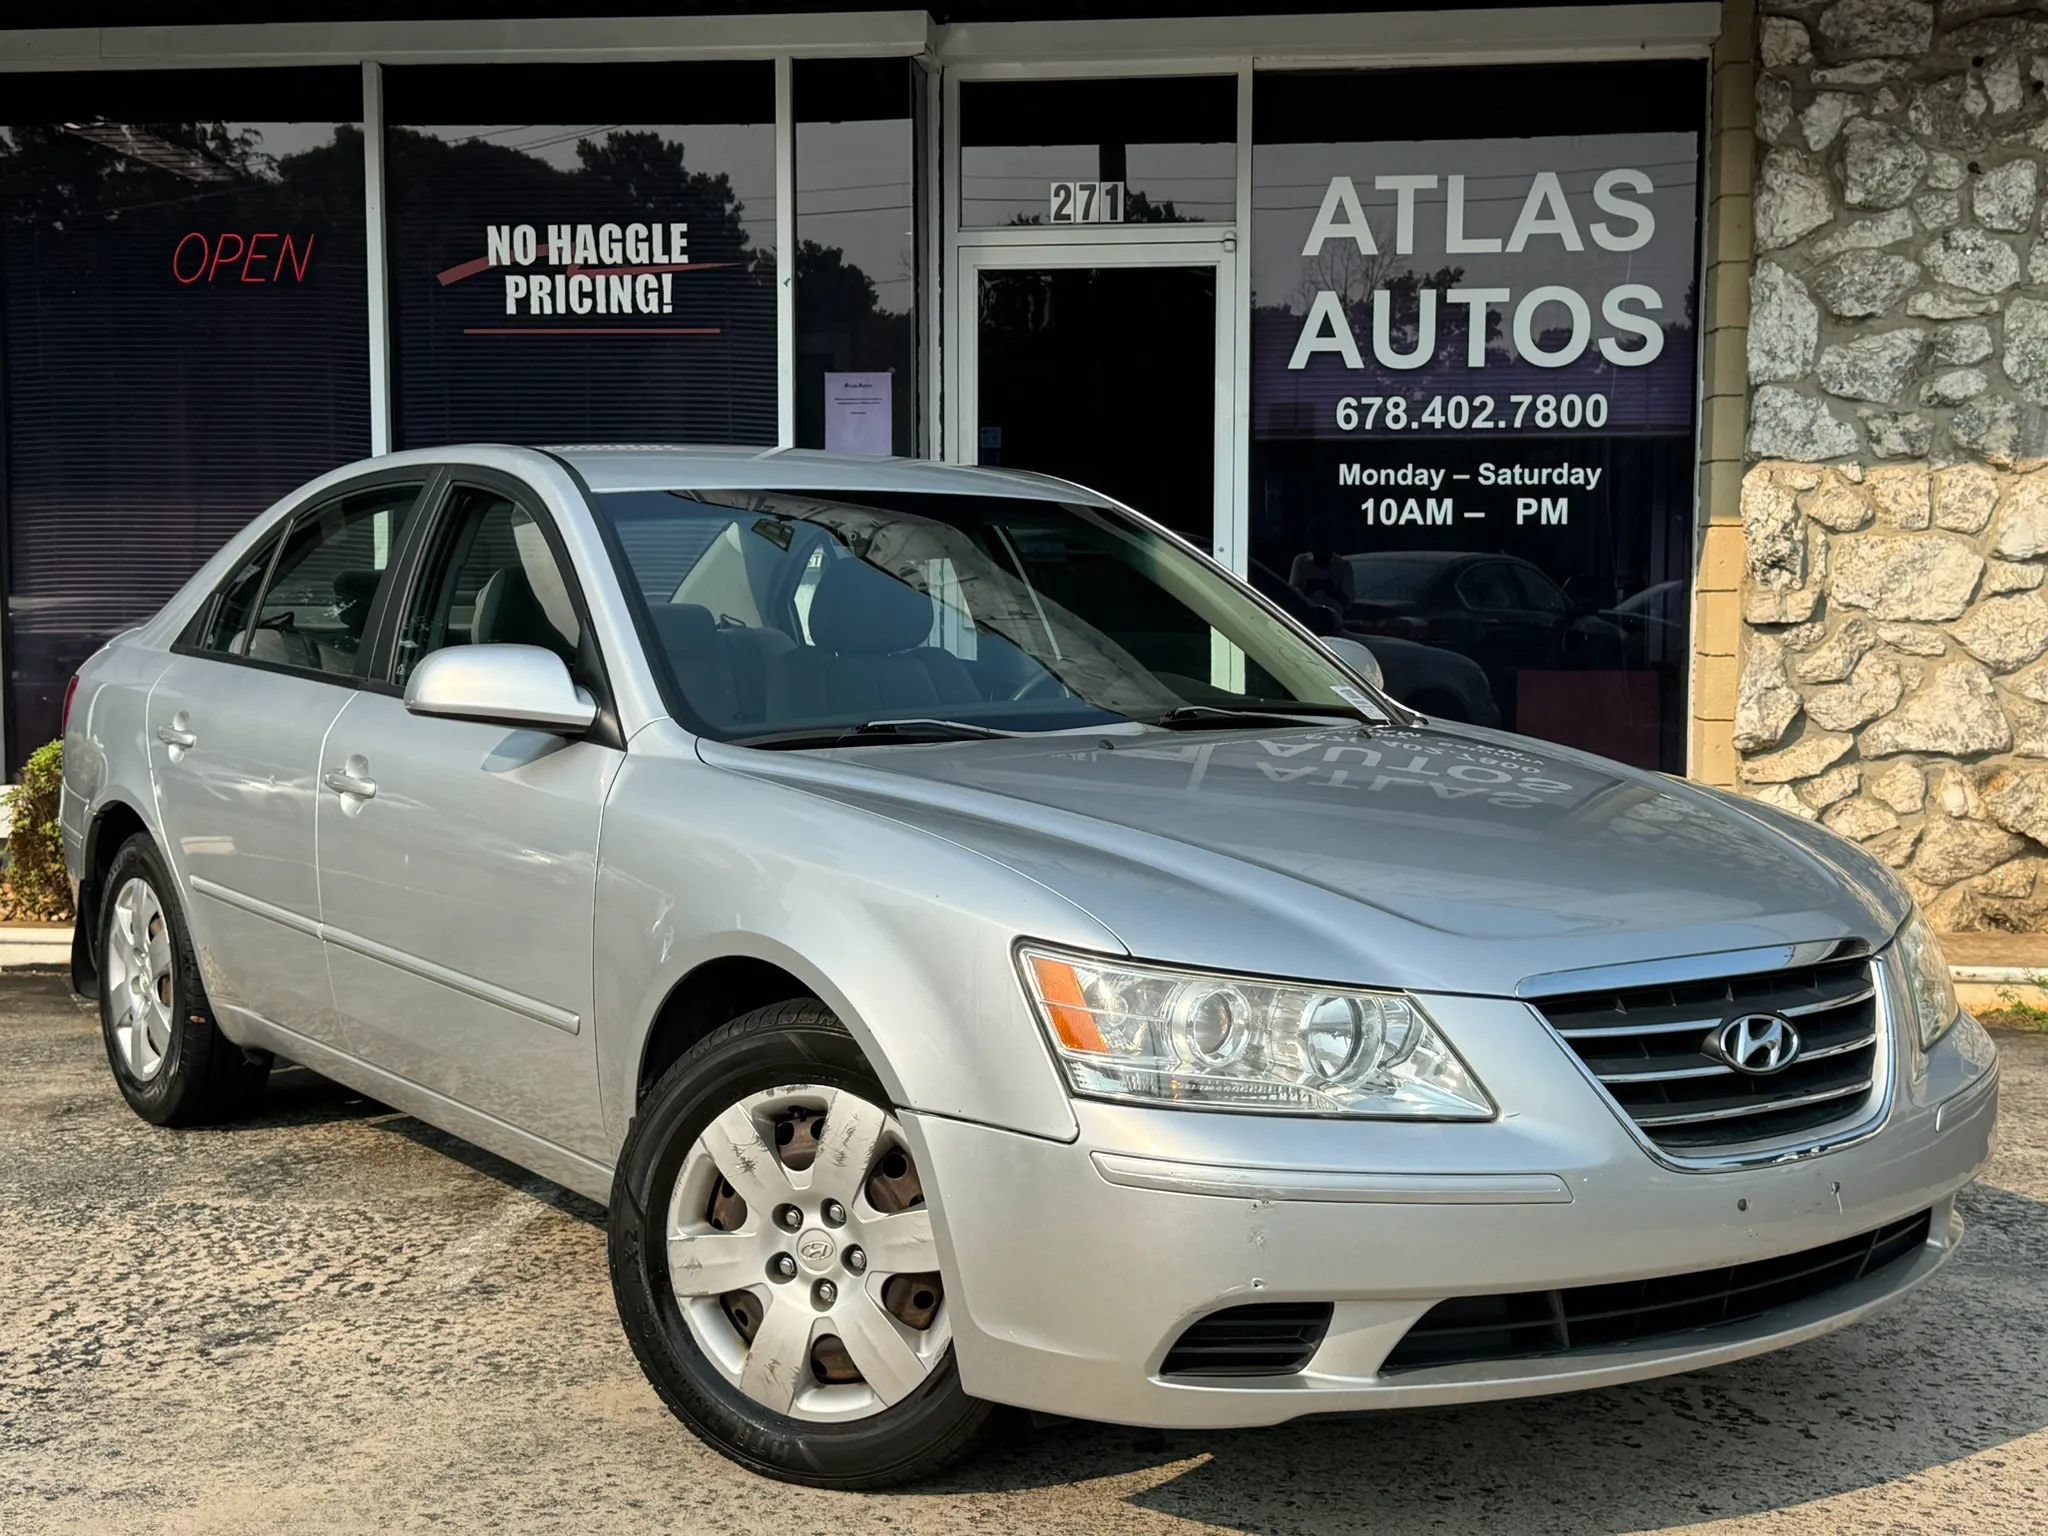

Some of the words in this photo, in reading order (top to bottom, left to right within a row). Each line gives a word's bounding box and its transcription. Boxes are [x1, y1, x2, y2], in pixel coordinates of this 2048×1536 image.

[1052, 183, 1119, 221] 271
[1301, 168, 1656, 256] ATLAS
[173, 232, 315, 284] OPEN
[487, 224, 537, 266] NO
[547, 222, 689, 265] HAGGLE
[504, 273, 673, 315] PRICING!
[1287, 283, 1665, 370] AUTOS
[1336, 393, 1609, 430] 678.402.7800
[1338, 463, 1446, 491] Monday
[1477, 462, 1602, 491] Saturday
[1361, 498, 1453, 525] 10AM
[1516, 497, 1569, 525] PM
